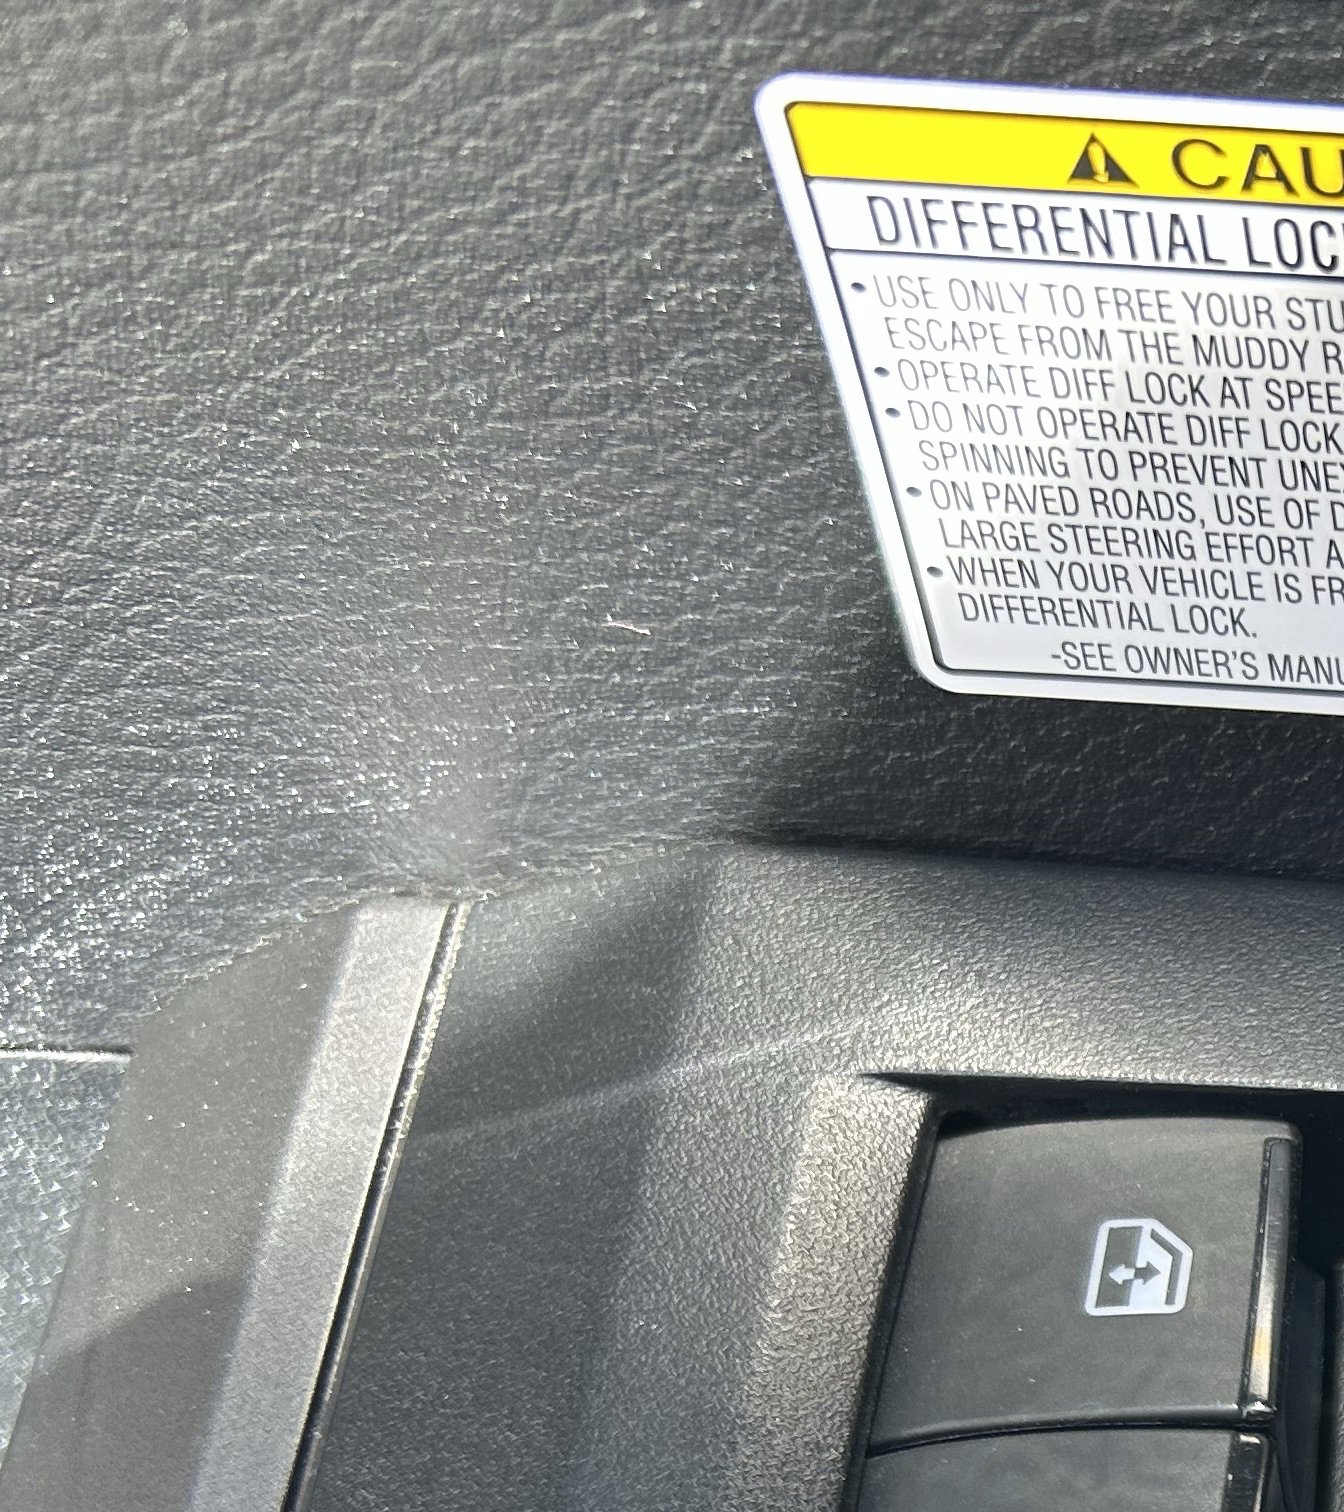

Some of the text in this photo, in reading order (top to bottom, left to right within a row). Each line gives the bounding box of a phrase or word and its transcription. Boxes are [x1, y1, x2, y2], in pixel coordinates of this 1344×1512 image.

[865, 194, 1226, 265] DIFFERENTIAL
[872, 274, 937, 309] USE
[947, 277, 1028, 314] ONLY
[1039, 282, 1085, 318] TO
[1093, 285, 1175, 324] FREE
[1180, 290, 1276, 329] YOUR
[883, 315, 1008, 355] ESCAPE
[1017, 323, 1112, 361] FROM
[1117, 328, 1184, 366] THE
[1191, 333, 1310, 372] MUDDY
[896, 357, 1041, 398] OPERATE
[1047, 366, 1114, 401] DIFF
[1124, 369, 1210, 408] LOCK
[1219, 375, 1250, 410] AT
[906, 398, 953, 433] DO
[961, 401, 1023, 436] NOT
[1035, 405, 1178, 446] OPERATE
[1184, 413, 1251, 449] DIFF
[1259, 417, 1344, 456] LOCK
[917, 438, 1071, 478] SPINNING
[1074, 446, 1119, 481] TO
[1127, 449, 1266, 489] PREVENT
[928, 478, 974, 511] ON
[980, 481, 1080, 517] PAVED
[1087, 486, 1206, 532] ROADS,
[1212, 493, 1275, 528] USE
[1282, 497, 1321, 530] OF
[937, 517, 1041, 553] LARGE
[1046, 521, 1197, 561] STEERING
[1203, 530, 1311, 568] EFFORT
[945, 555, 1041, 589] WHEN
[1044, 559, 1134, 594] YOUR
[1137, 564, 1266, 602] VEHICLE
[1272, 572, 1303, 604] IS
[956, 591, 1257, 638] DIFFERENTIAL LOCK.
